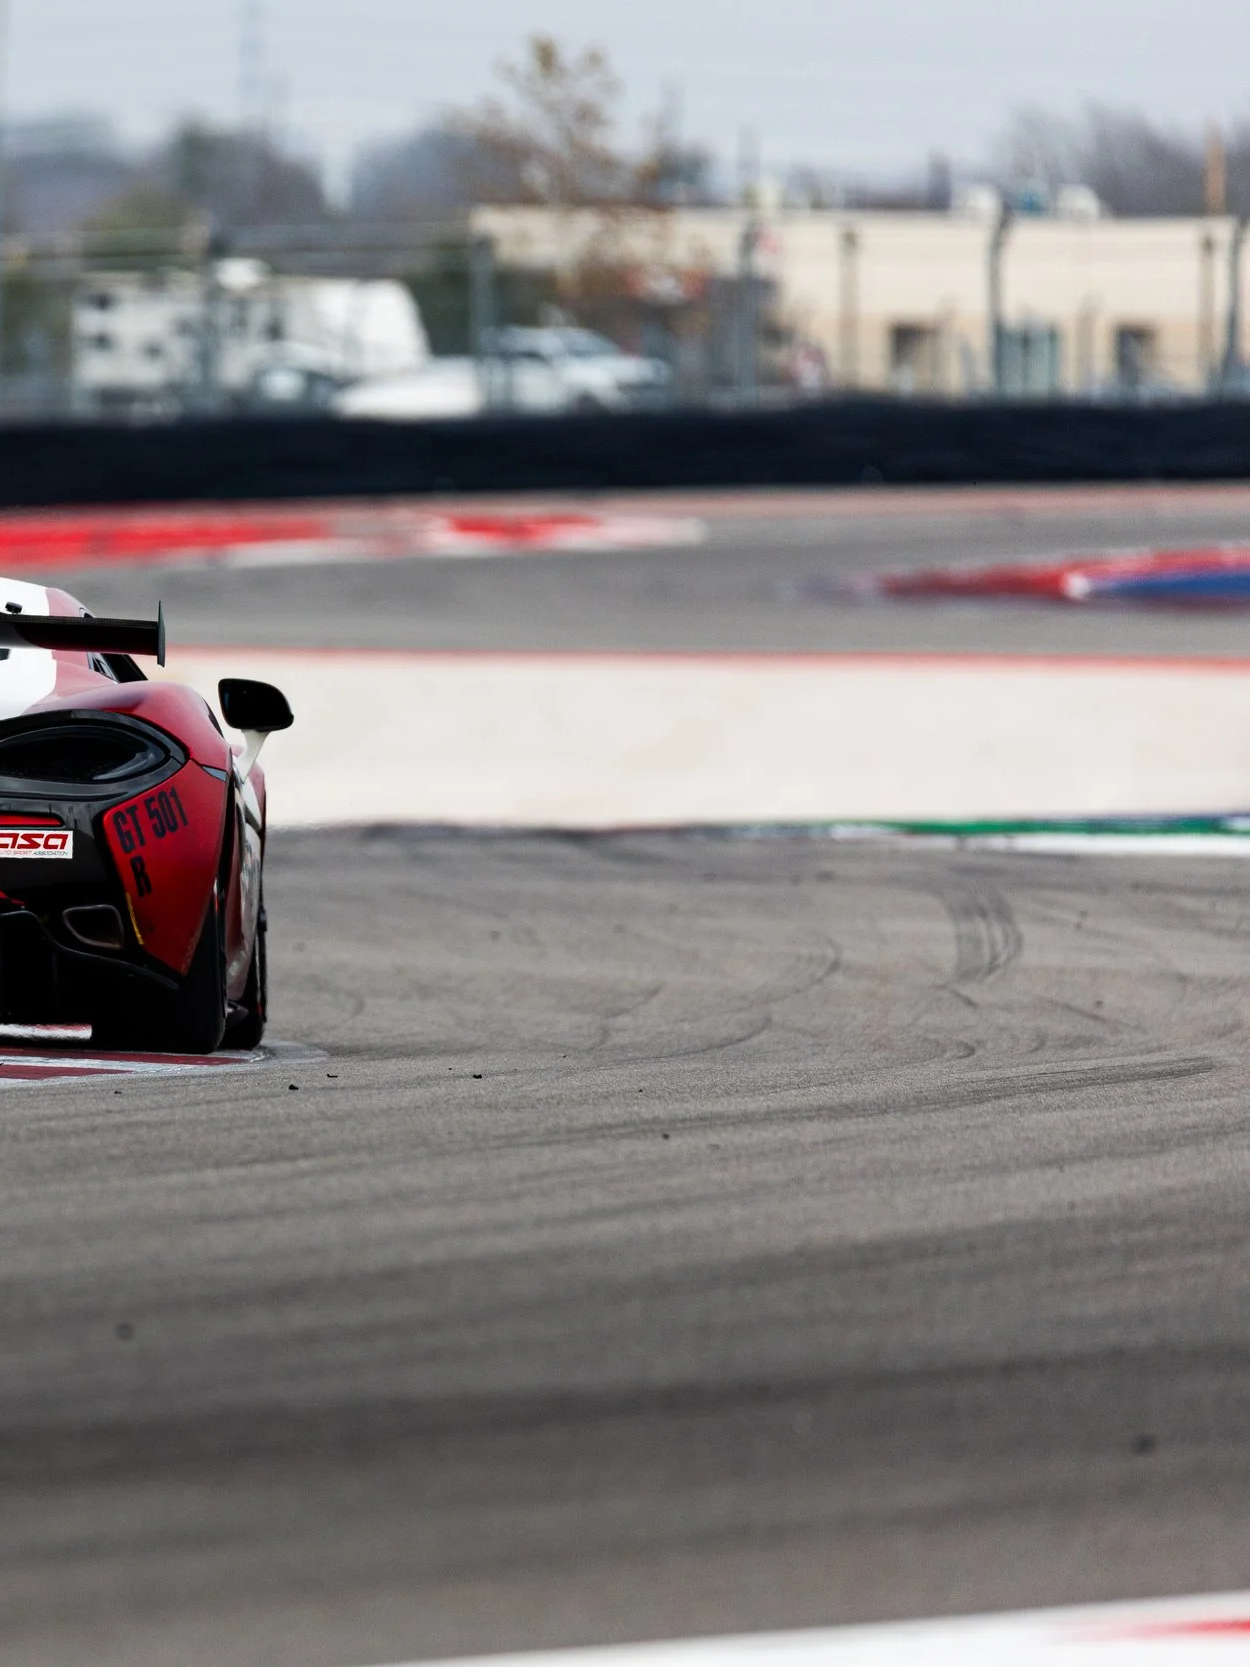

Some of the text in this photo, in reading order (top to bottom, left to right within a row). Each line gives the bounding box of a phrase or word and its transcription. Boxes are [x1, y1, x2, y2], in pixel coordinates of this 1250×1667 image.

[112, 786, 188, 854] GT 501
[130, 855, 152, 897] R
